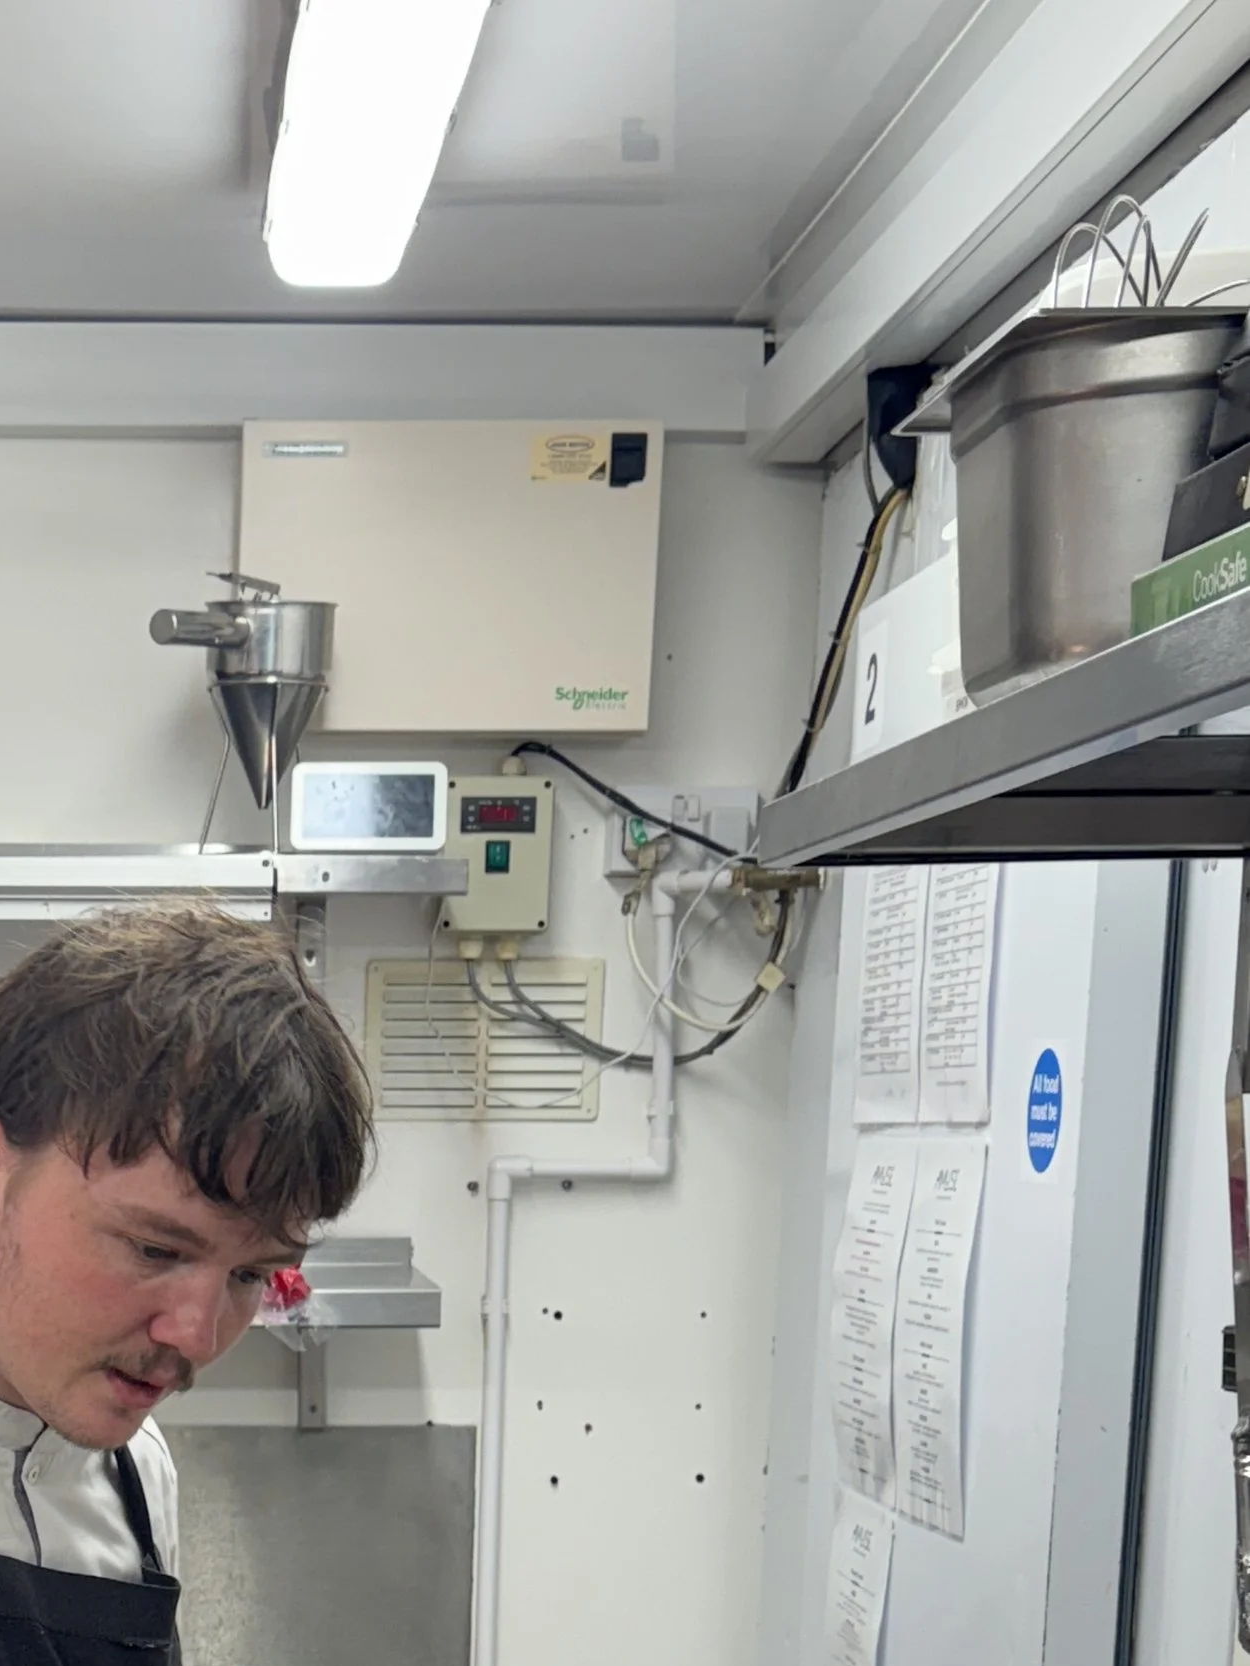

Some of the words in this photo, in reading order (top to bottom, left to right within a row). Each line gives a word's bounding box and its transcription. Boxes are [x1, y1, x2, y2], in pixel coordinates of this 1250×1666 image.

[1192, 550, 1247, 602] CookSafe
[555, 686, 628, 710] Schneider
[864, 653, 877, 725] 2
[1033, 1074, 1044, 1095] All
[1044, 1073, 1059, 1094] food
[1031, 1102, 1047, 1120] must
[1048, 1101, 1057, 1121] be
[1029, 1128, 1056, 1149] covered
